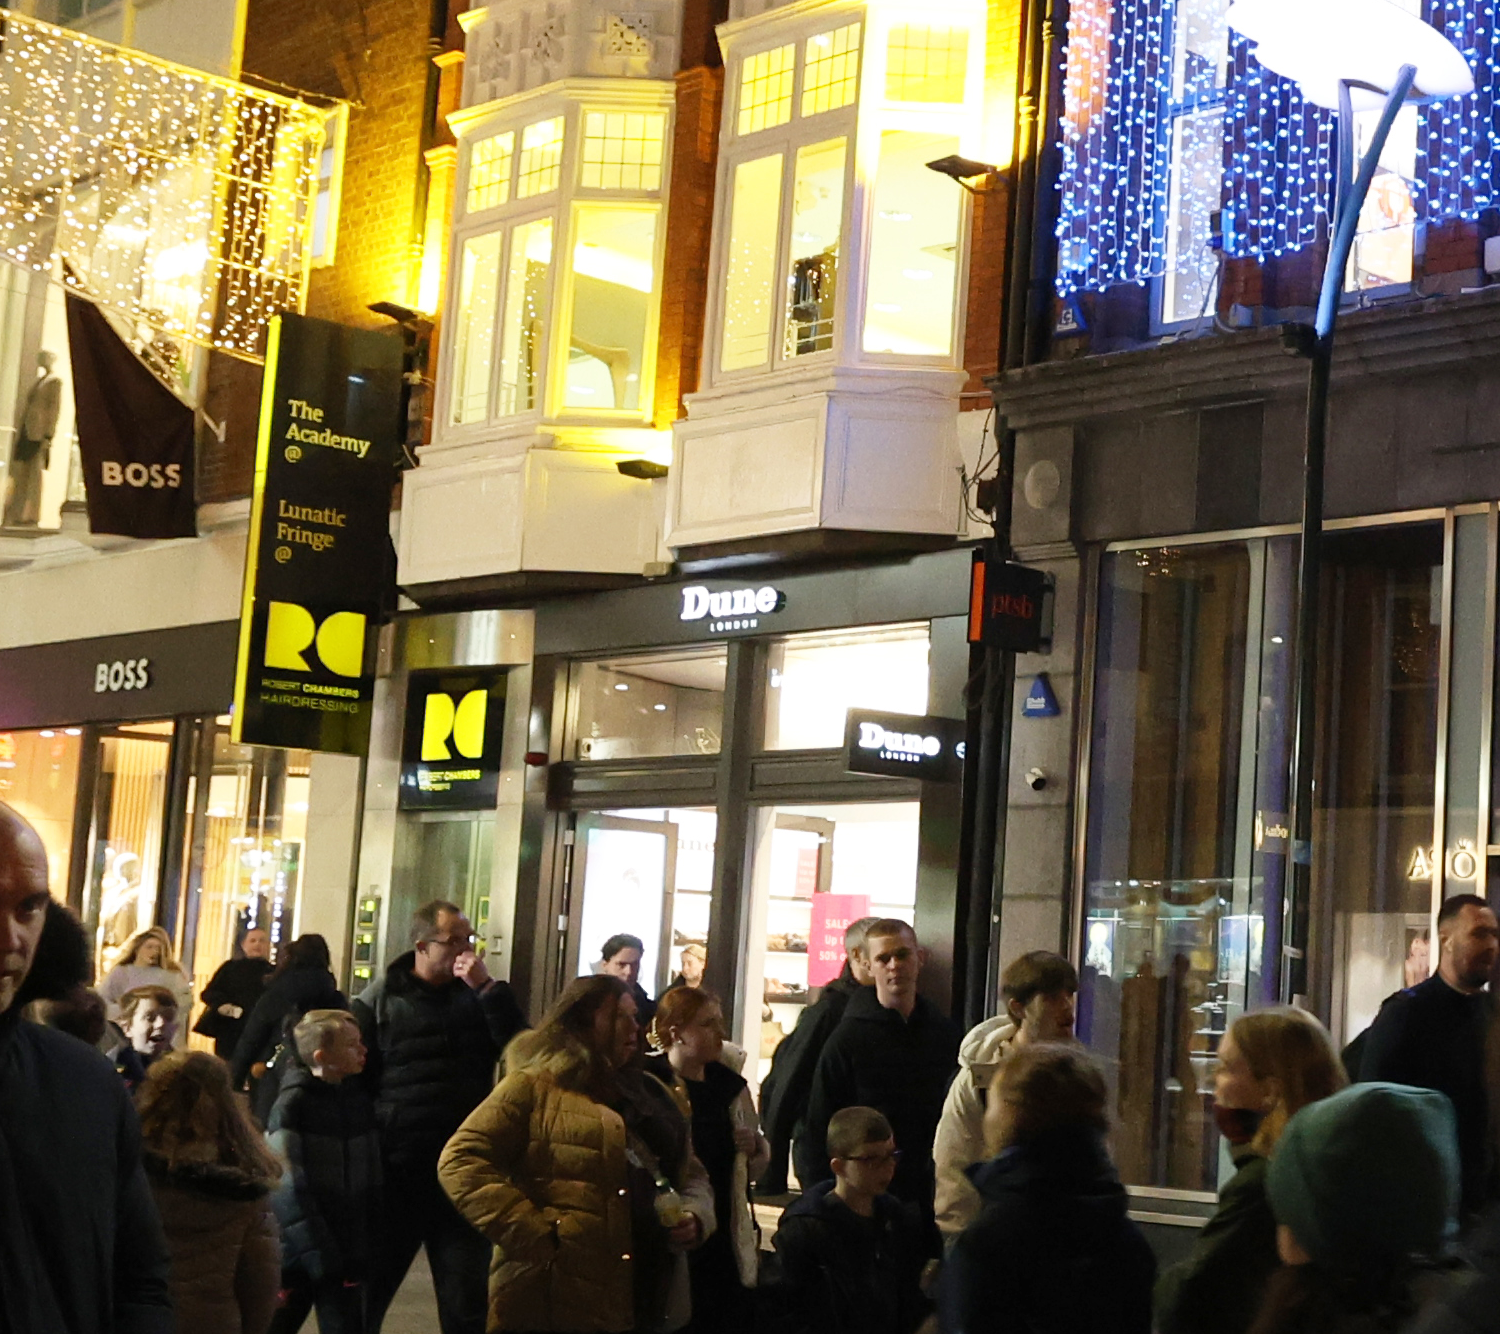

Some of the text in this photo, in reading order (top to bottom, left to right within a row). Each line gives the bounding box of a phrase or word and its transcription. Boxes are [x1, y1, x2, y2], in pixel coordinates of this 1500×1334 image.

[287, 399, 324, 423] The
[285, 423, 371, 458] Academy
[284, 445, 302, 464] @
[102, 461, 180, 488] BOSS
[279, 499, 347, 527] Lunatic
[276, 522, 335, 551] Fringe
[274, 545, 293, 564] @
[680, 585, 778, 620] Dune
[991, 594, 1034, 619] ptsb
[709, 619, 758, 633] LONDON
[94, 657, 149, 693] BOSS
[260, 692, 359, 714] HAIRDRESSING
[302, 683, 360, 699] CHAMBERS
[858, 722, 941, 757] Dune
[824, 934, 838, 947] Up
[819, 950, 838, 962] 50%
